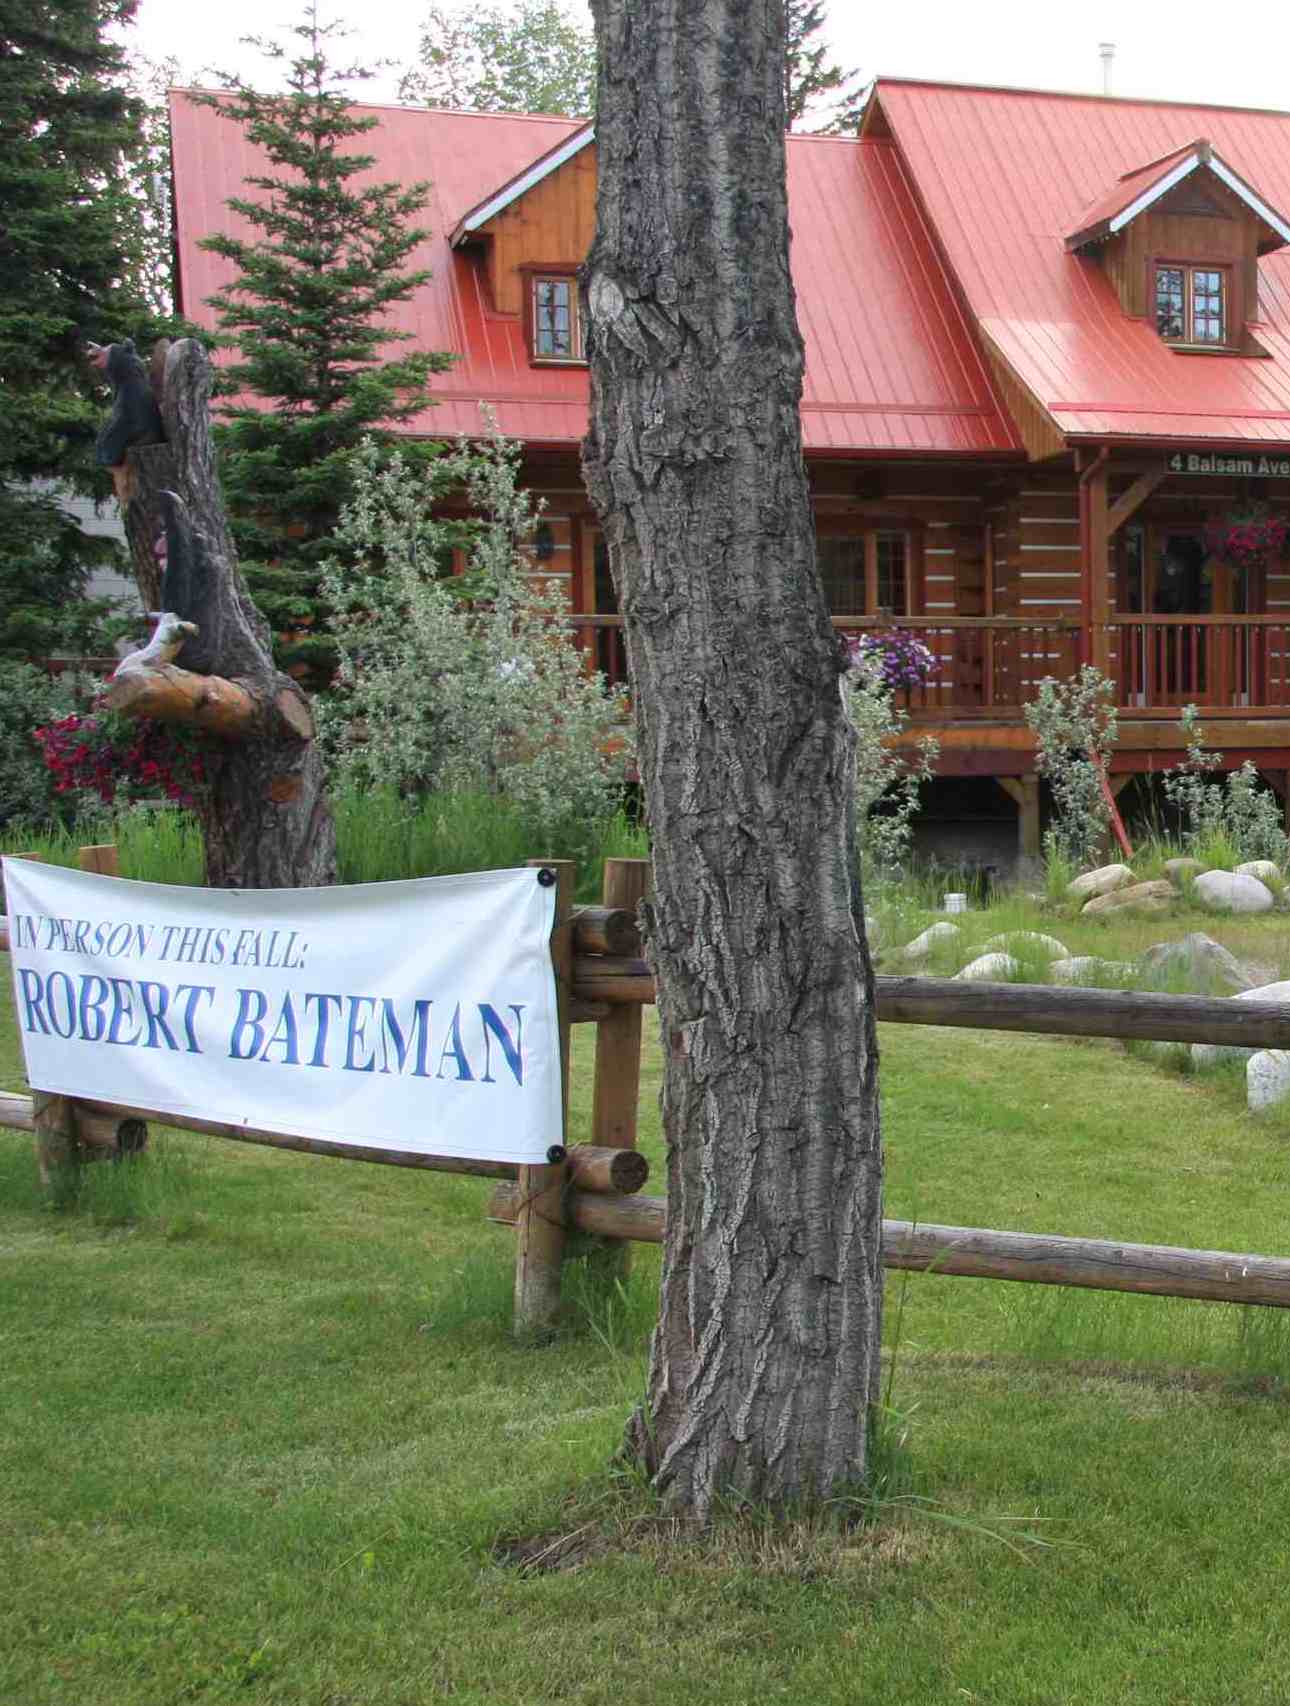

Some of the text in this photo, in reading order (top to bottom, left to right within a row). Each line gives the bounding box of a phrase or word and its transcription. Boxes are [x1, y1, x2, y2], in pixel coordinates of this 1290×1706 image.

[1170, 453, 1183, 471] 4
[1187, 454, 1252, 474] Balsam
[15, 914, 42, 950] IN
[45, 917, 153, 959] PERSON
[159, 926, 229, 965] THIS
[17, 967, 525, 1087] ROBERT BATEMAN
